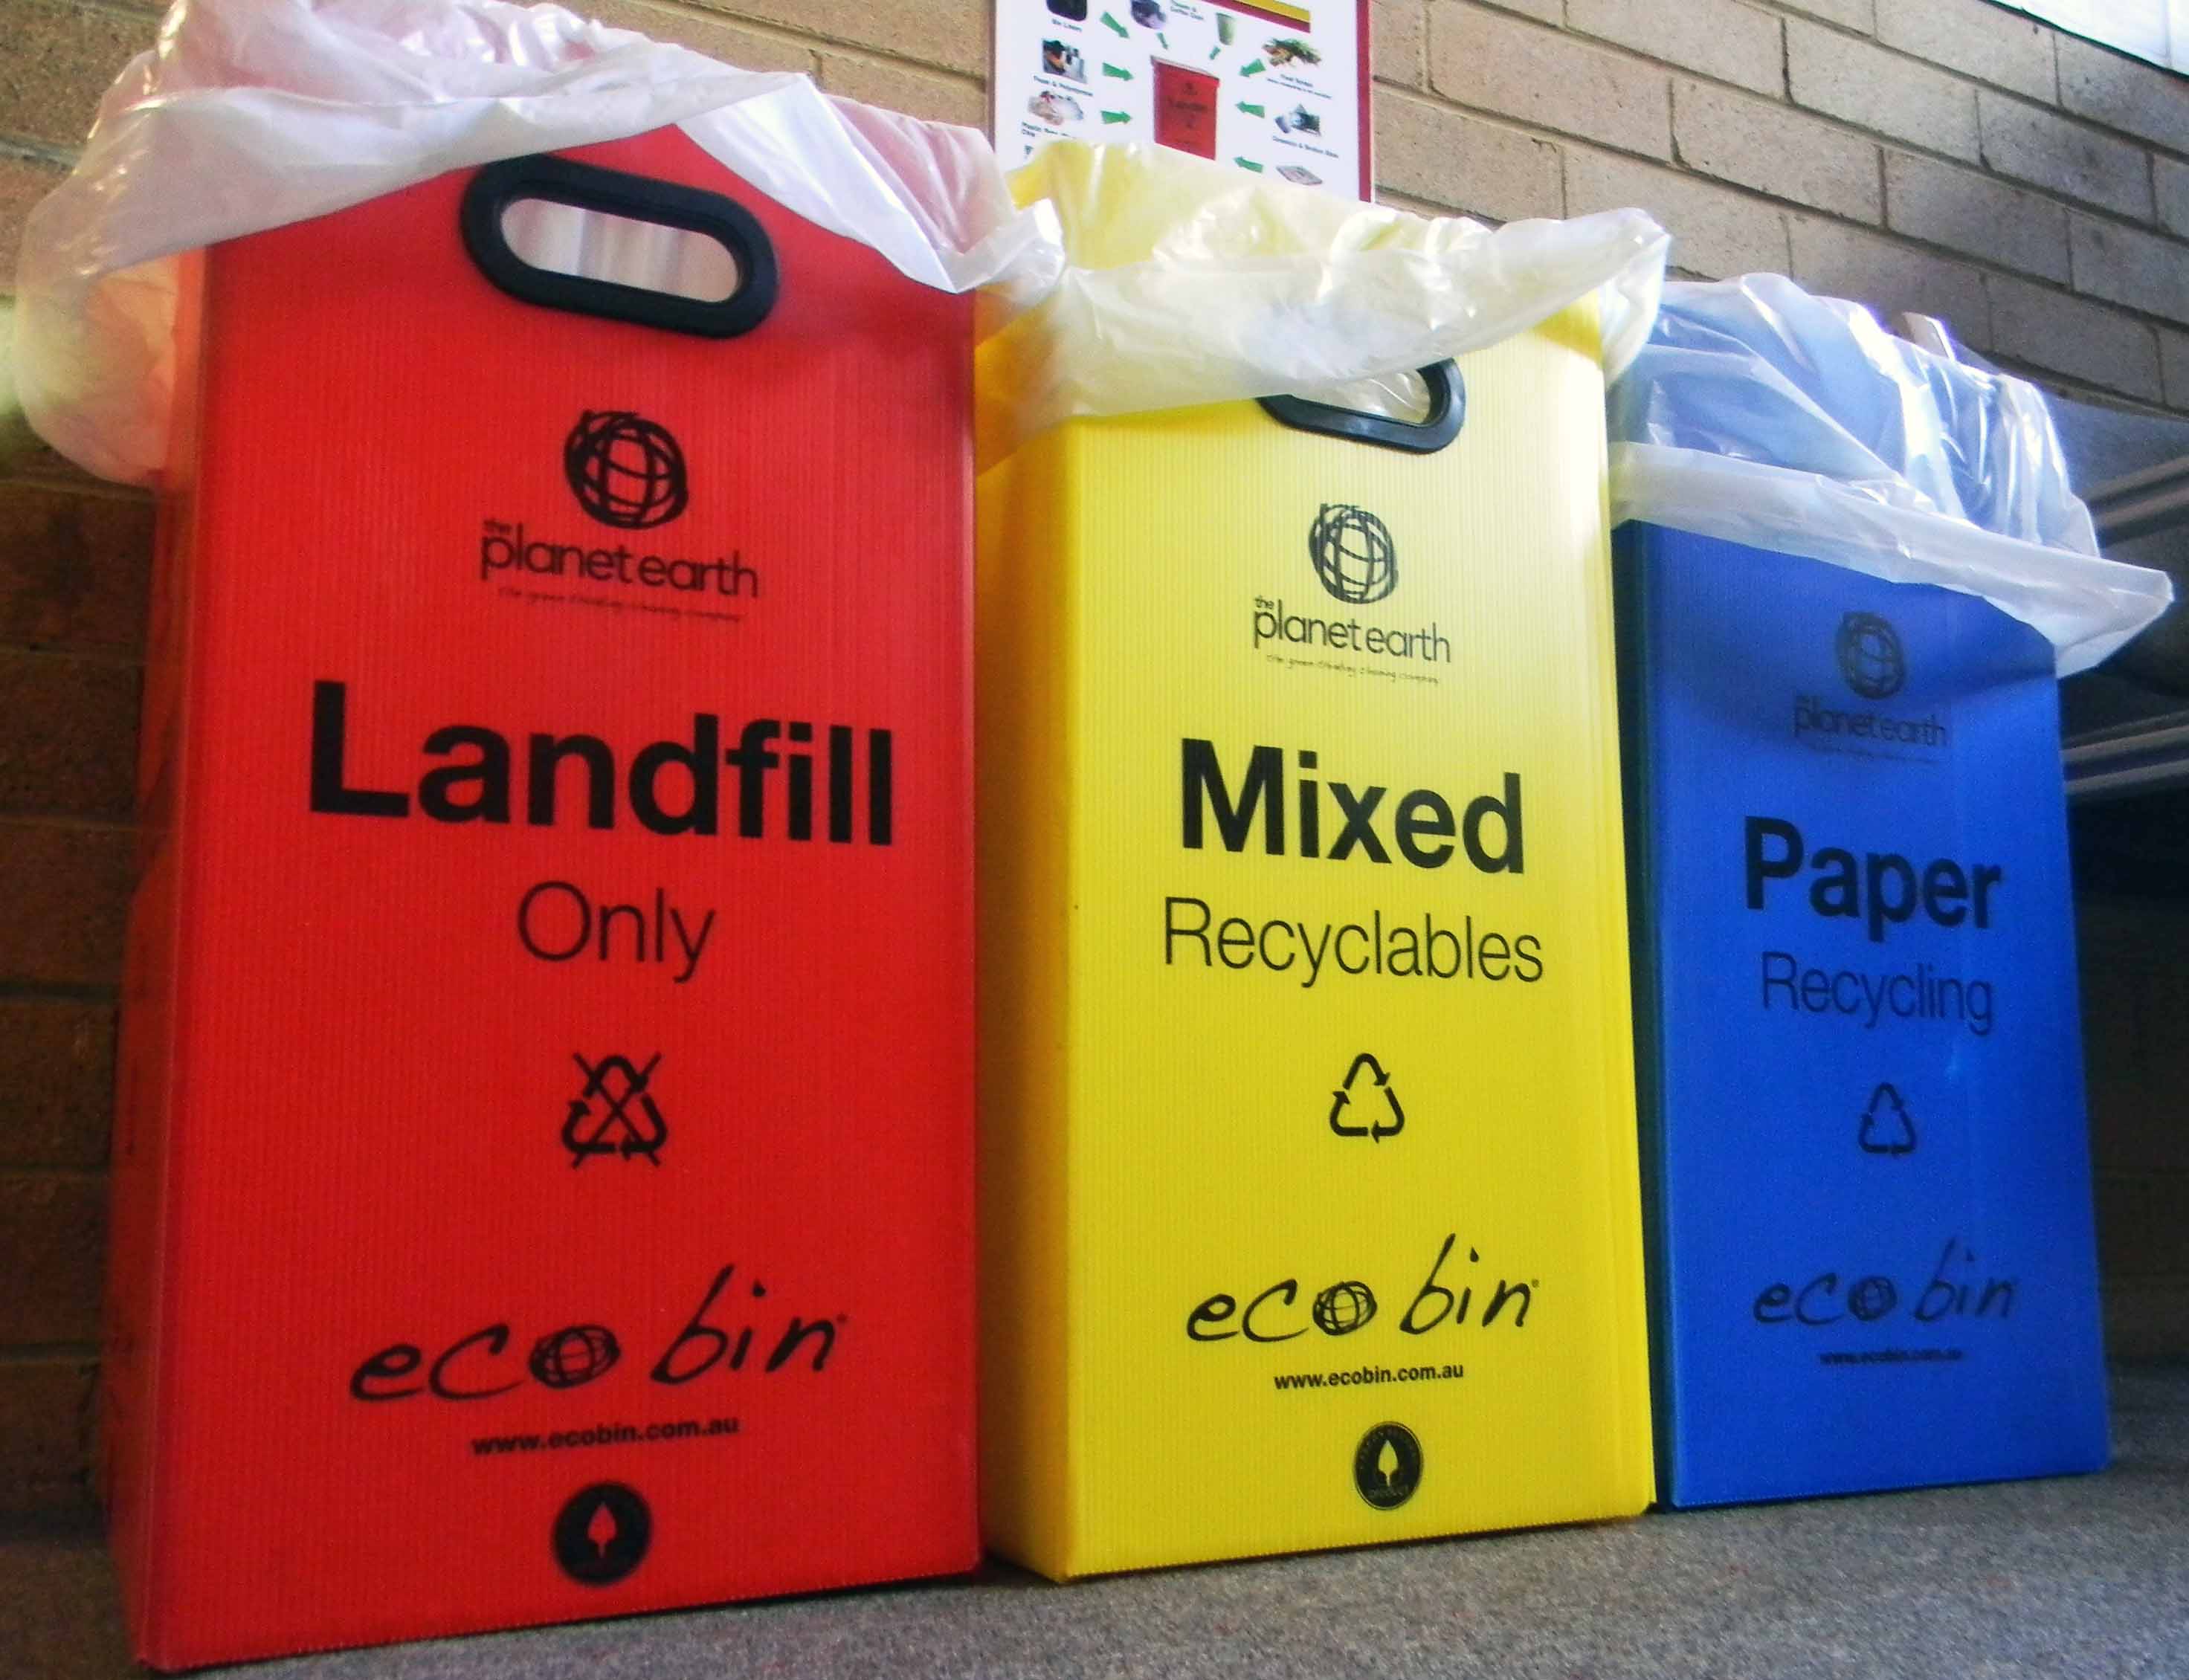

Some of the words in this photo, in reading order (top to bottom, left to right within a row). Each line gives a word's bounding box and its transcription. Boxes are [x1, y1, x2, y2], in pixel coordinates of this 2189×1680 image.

[309, 679, 893, 846] Landfill
[1181, 737, 1524, 875] Mixed
[1744, 815, 2002, 943] Paper
[517, 880, 716, 983] Only
[1164, 895, 1544, 989] Recyclables
[1761, 950, 1993, 1037] Recycling
[1273, 1363, 1465, 1391] www.ecobin.com.au
[472, 1416, 740, 1457] www.ecobin.com.au
